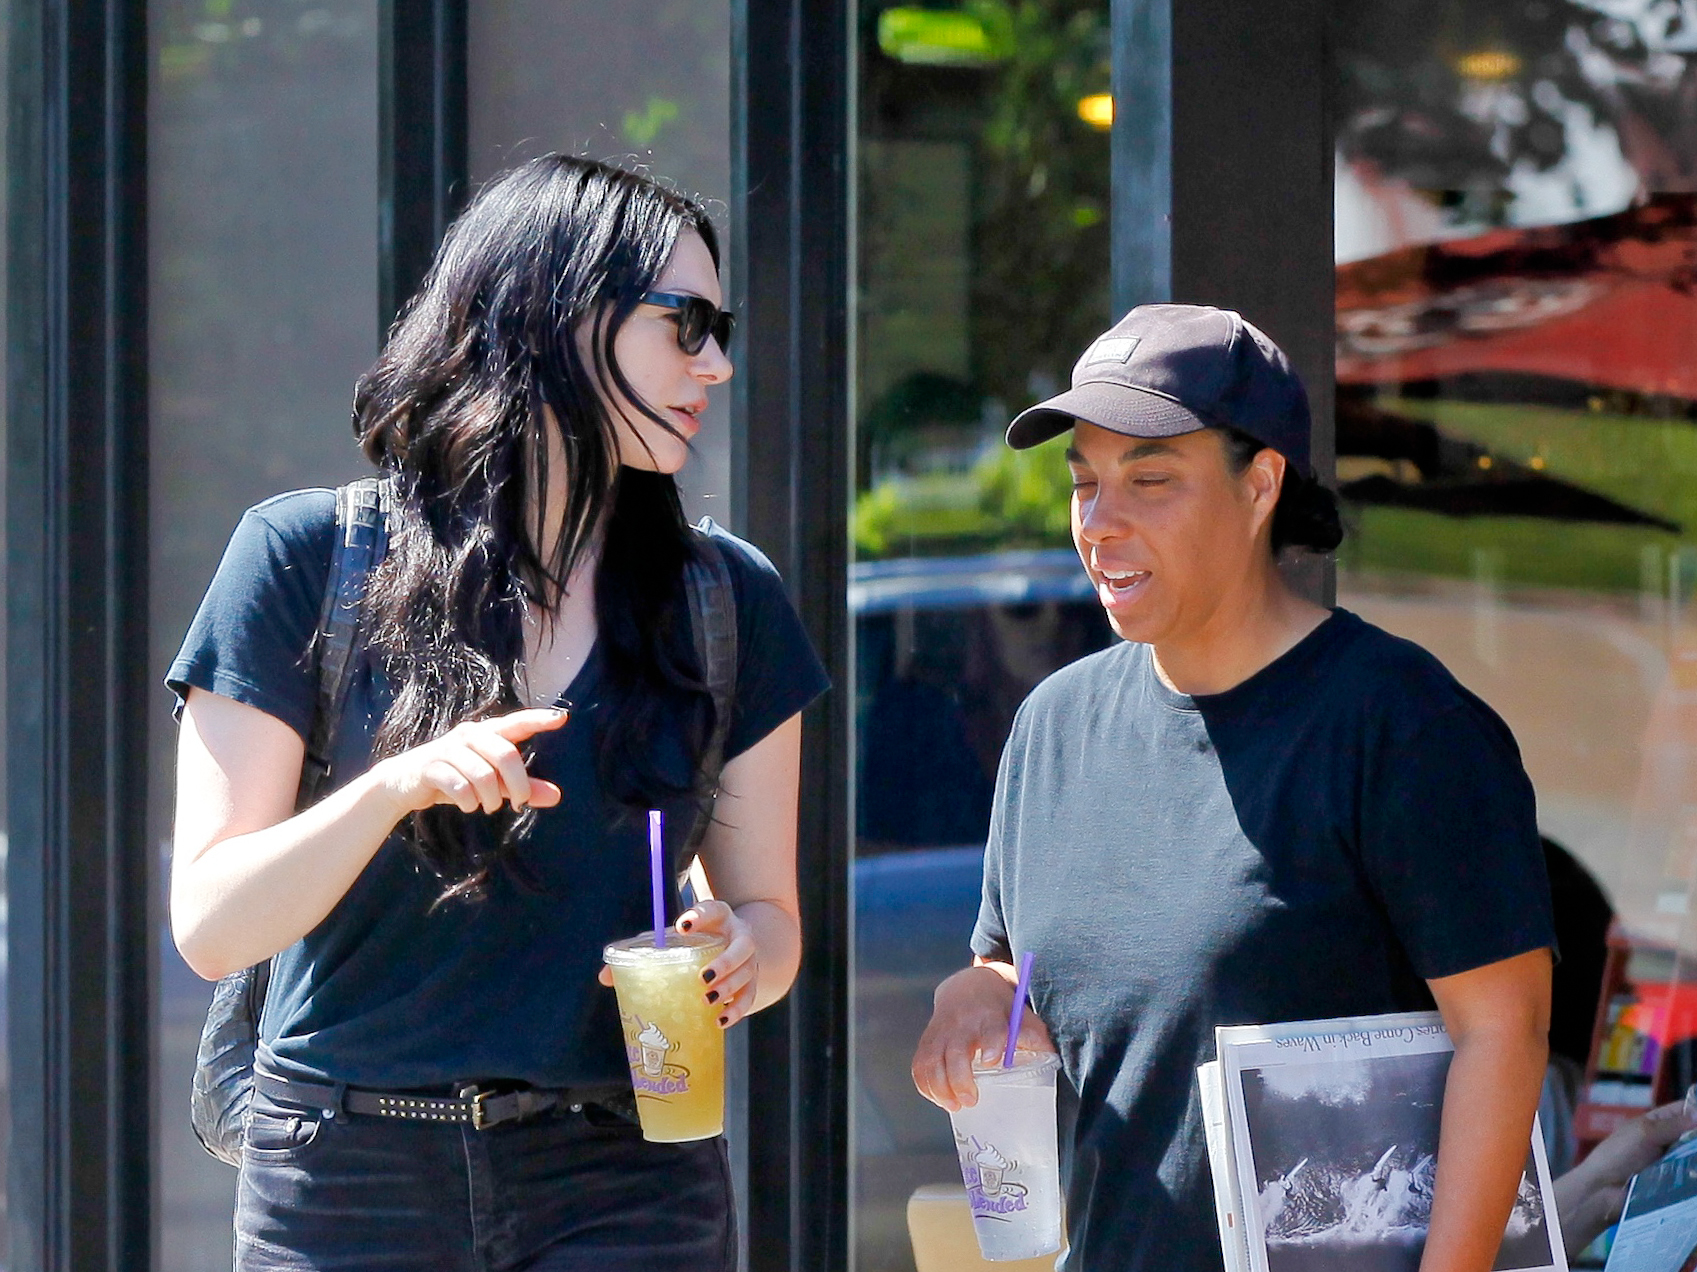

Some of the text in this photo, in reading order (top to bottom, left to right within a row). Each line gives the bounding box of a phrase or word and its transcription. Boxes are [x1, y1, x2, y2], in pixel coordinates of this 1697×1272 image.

[1276, 1034, 1321, 1052] Waves
[1322, 1034, 1337, 1049] in
[1340, 1030, 1372, 1048] Back
[1374, 1027, 1414, 1044] Come
